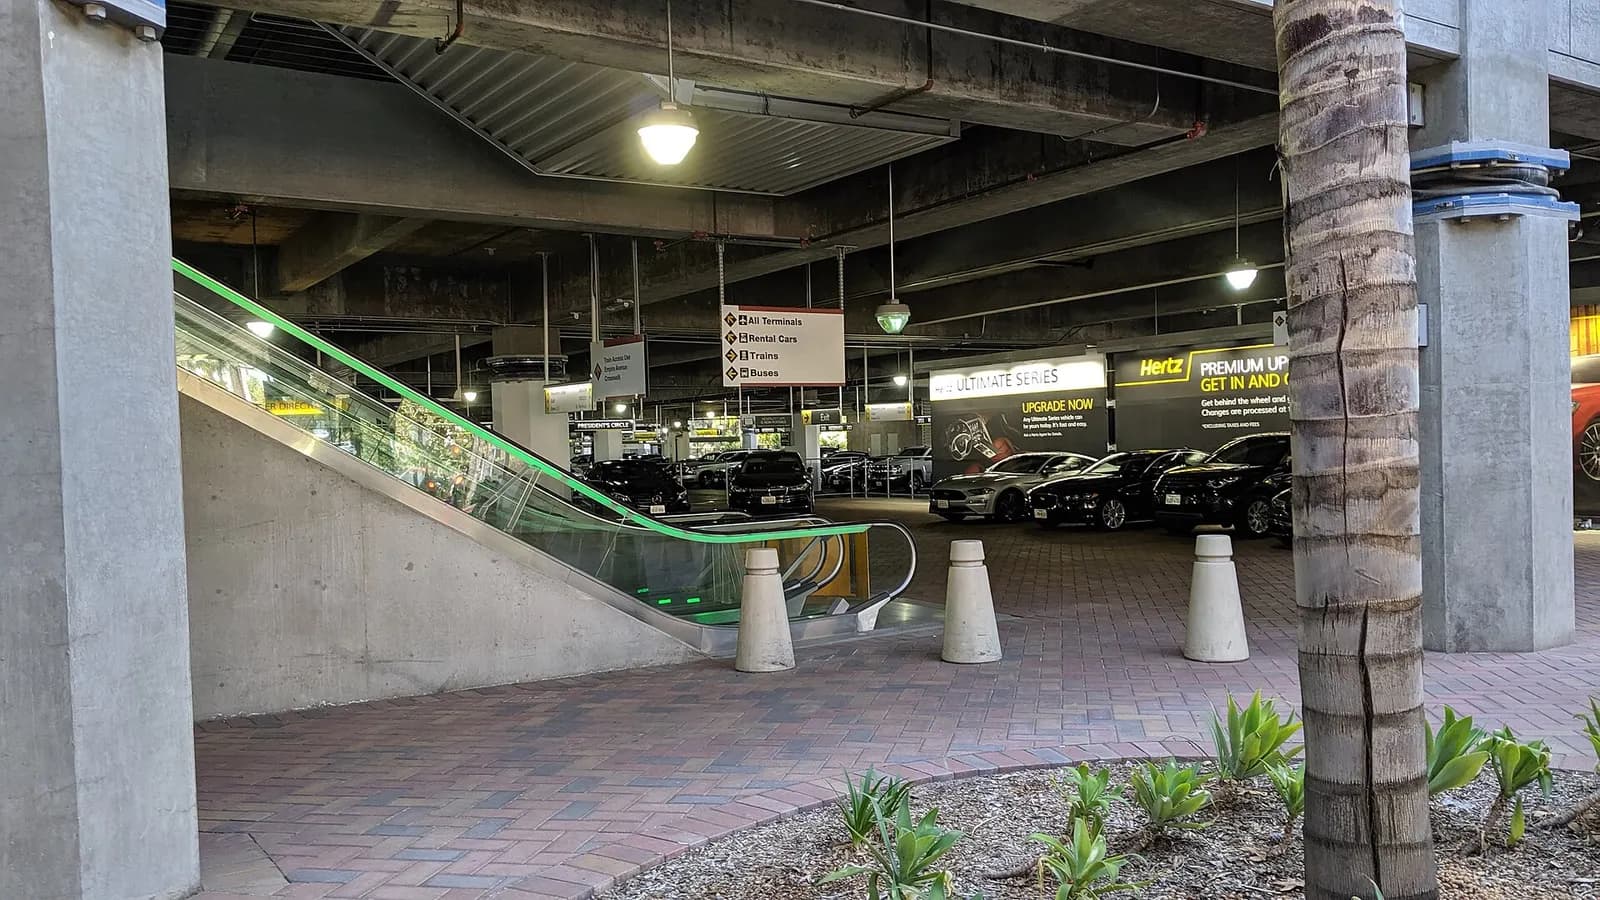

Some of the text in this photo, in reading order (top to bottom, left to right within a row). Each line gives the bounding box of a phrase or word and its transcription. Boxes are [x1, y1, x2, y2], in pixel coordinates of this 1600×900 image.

[762, 317, 802, 326] Terminals
[749, 334, 798, 343] Rental Cars
[750, 352, 779, 360] Trains
[1140, 357, 1184, 376] Hertz
[1200, 355, 1289, 376] PREMIUM UP
[751, 369, 779, 377] Buses
[957, 373, 1012, 391] ULTIMATE
[1016, 368, 1058, 386] SERIES
[1200, 377, 1227, 392] GET
[1230, 375, 1245, 390] IN
[1248, 373, 1281, 388] AND
[1022, 398, 1094, 413] UPGRADE NOW
[1201, 399, 1214, 407] Get
[1214, 398, 1237, 406] behind
[1237, 397, 1249, 405] the
[1249, 396, 1271, 404] wheel
[1271, 395, 1286, 403] and
[1201, 409, 1230, 417] Changes
[1242, 406, 1277, 416] processed
